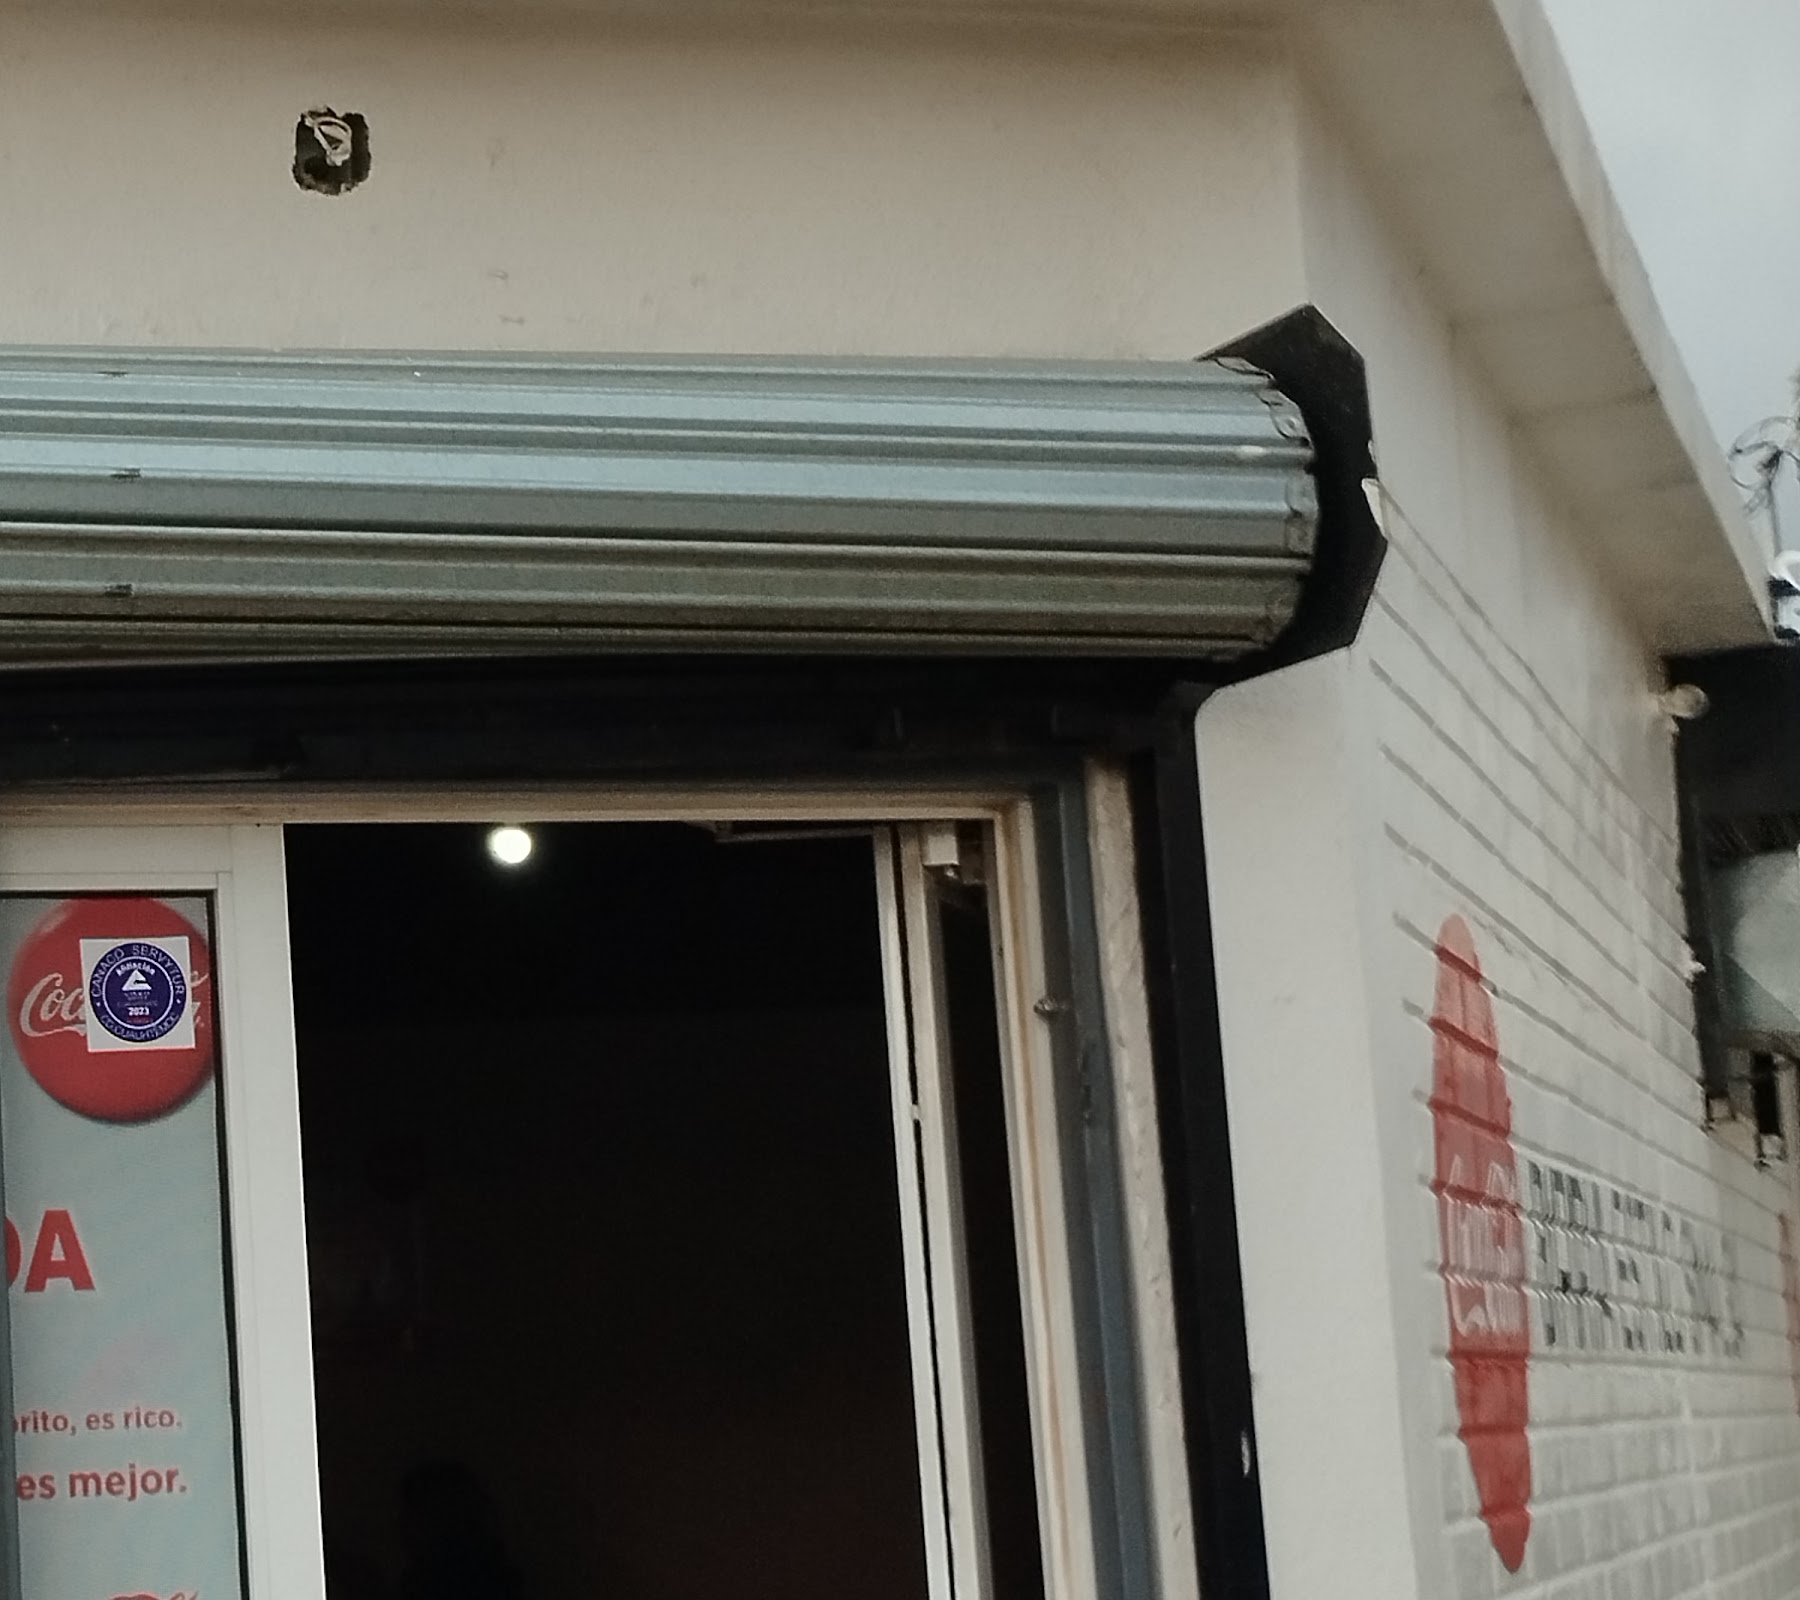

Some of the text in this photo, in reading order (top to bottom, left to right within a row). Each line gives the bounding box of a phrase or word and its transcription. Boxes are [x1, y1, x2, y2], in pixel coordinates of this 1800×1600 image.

[90, 944, 186, 998] CANACO SERVYTUR
[85, 1410, 115, 1431] es
[123, 1405, 183, 1430] rico.
[16, 1473, 56, 1500] es
[68, 1462, 187, 1502] mejor.
